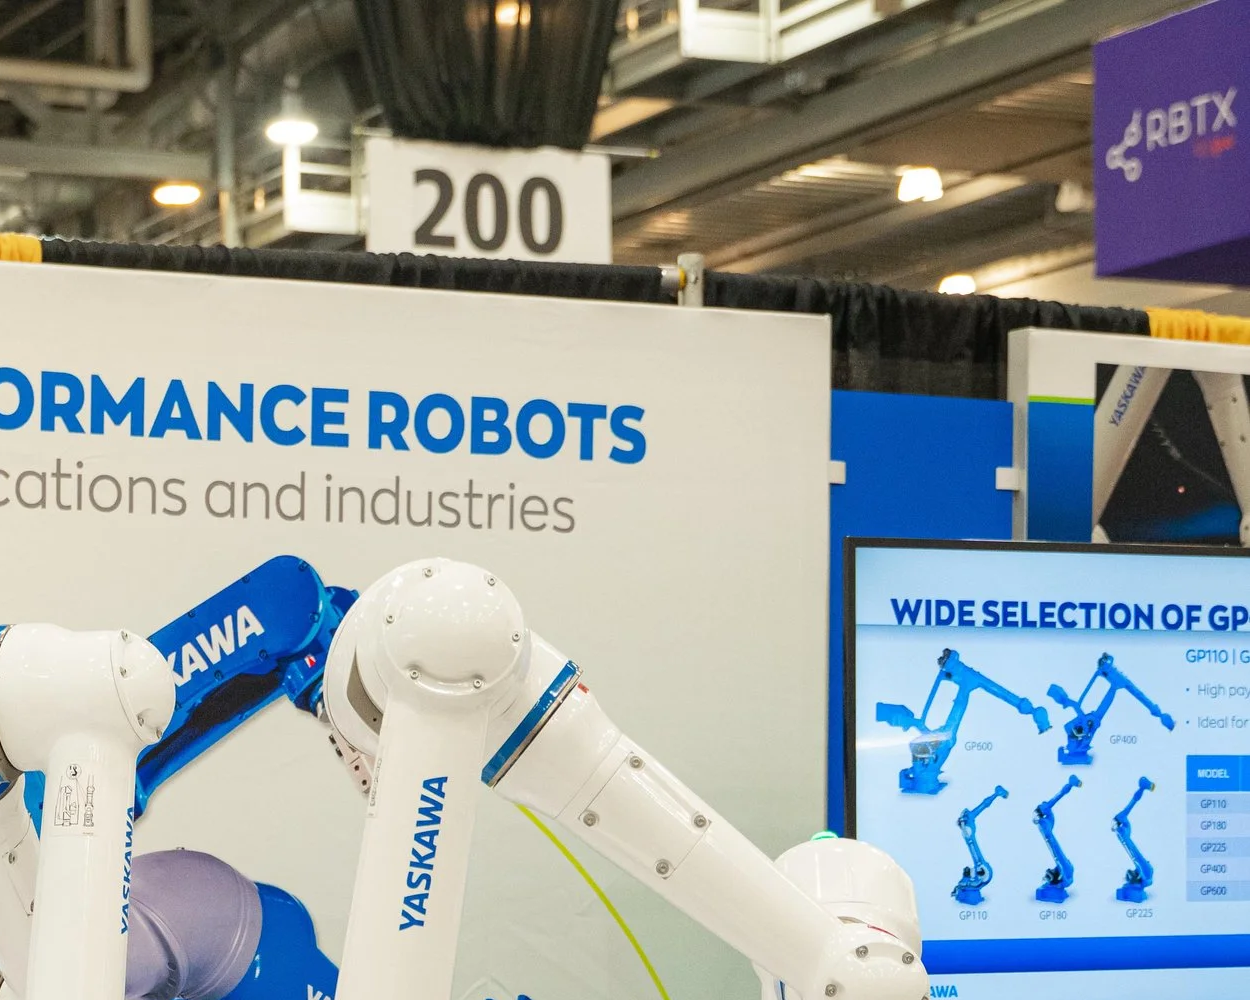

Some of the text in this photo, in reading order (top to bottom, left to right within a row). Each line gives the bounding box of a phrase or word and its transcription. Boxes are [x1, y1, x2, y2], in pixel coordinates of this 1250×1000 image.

[1146, 87, 1238, 151] RBTX
[414, 169, 562, 254] 200
[1109, 366, 1147, 427] YASKAW
[367, 390, 647, 465] ROBOTS
[205, 471, 306, 521] and
[325, 474, 575, 534] industries
[890, 598, 1250, 631] WIDE SELECTION OF GP
[1185, 649, 1228, 663] GP110
[1197, 683, 1225, 698] High
[1197, 716, 1249, 728] Ideal for
[1110, 735, 1137, 745] GP400
[1197, 769, 1229, 778] MODEL
[1200, 799, 1227, 809] GP110
[1200, 820, 1227, 830] GP180
[1200, 842, 1227, 852] GP225
[399, 776, 448, 931] YASKAWA
[1200, 864, 1227, 874] GP400
[1200, 886, 1227, 896] GP600
[959, 911, 987, 920] GP110
[1039, 910, 1067, 920] GP180
[1126, 909, 1153, 918] GP225
